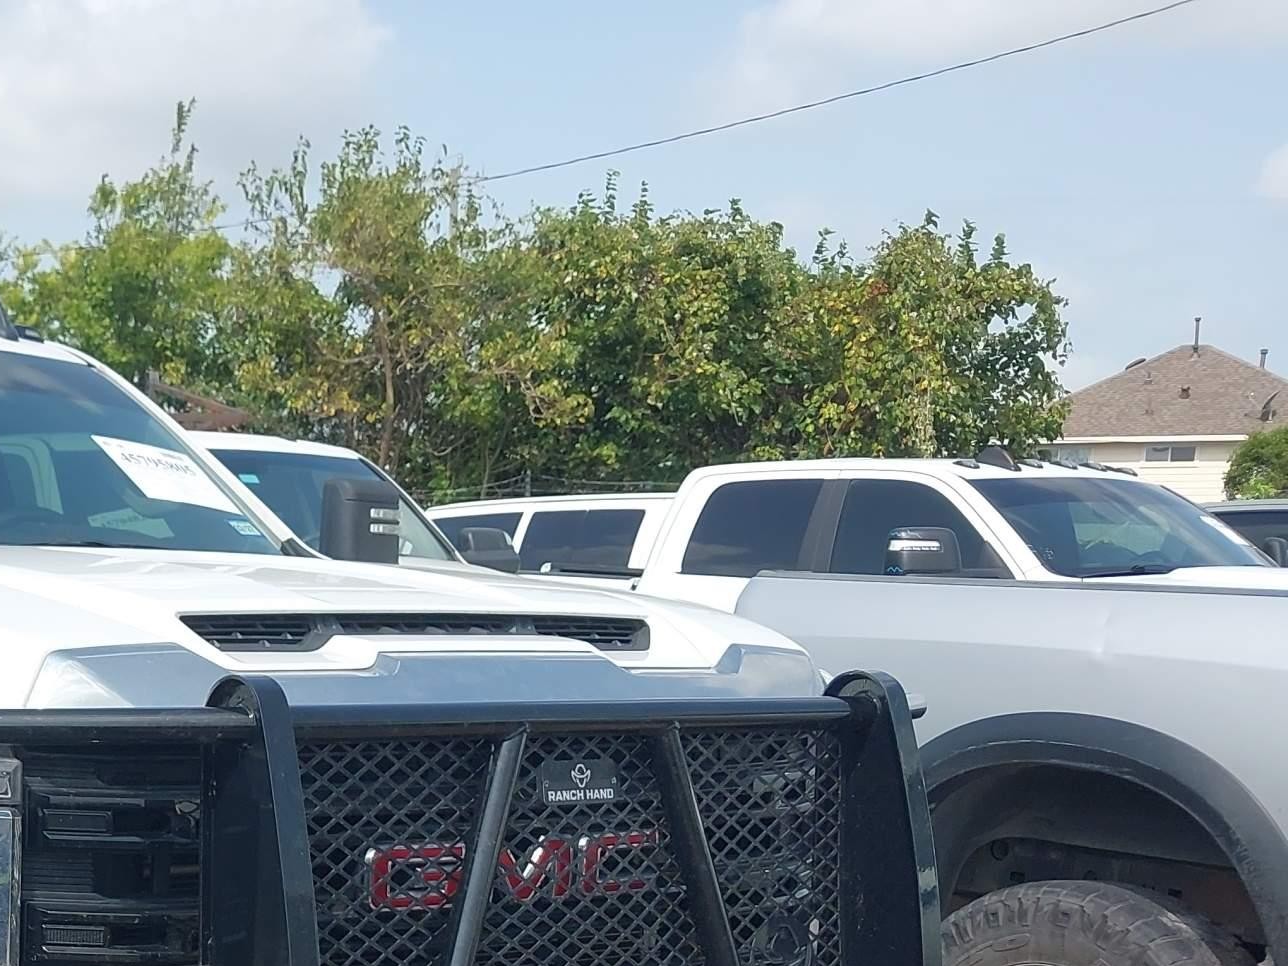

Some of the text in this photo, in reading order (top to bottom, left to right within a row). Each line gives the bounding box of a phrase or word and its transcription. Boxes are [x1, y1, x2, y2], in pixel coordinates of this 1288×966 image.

[548, 788, 615, 802] RANCH HAND
[365, 830, 661, 912] GMC
